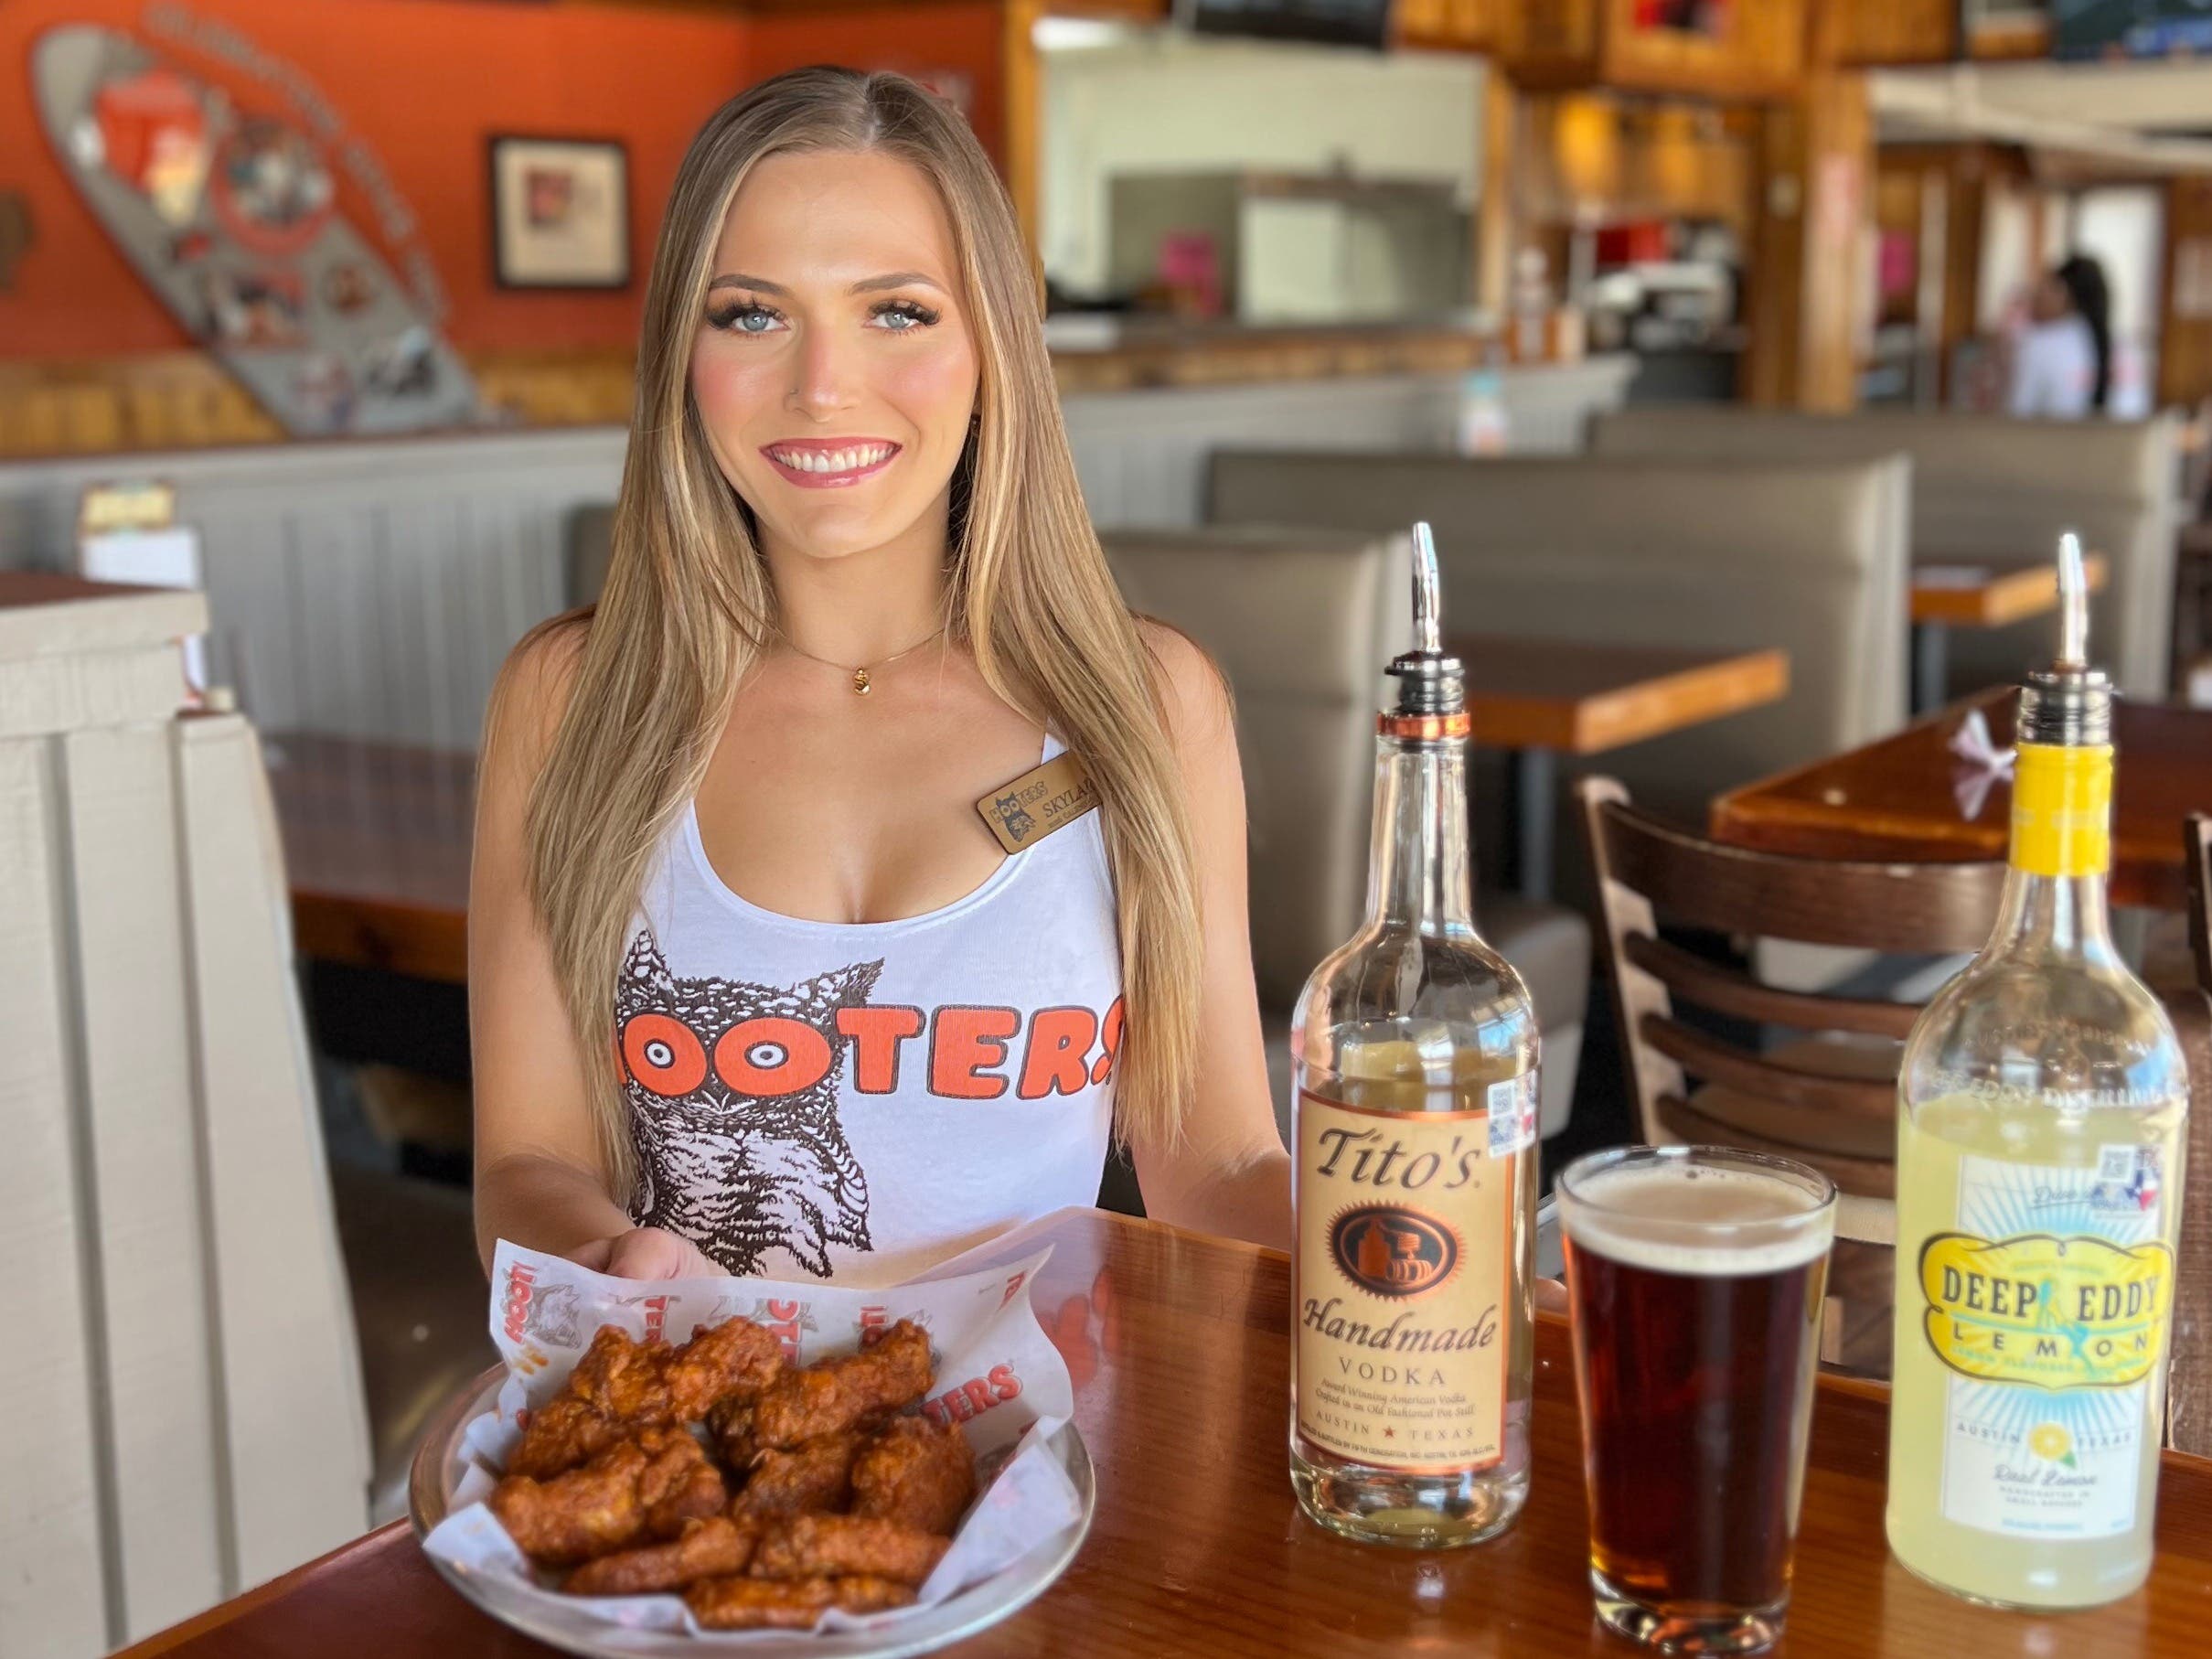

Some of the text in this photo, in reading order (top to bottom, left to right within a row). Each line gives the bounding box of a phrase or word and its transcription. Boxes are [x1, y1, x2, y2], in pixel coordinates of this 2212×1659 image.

[988, 780, 1048, 823] HOOTERS
[610, 994, 1125, 1099] OOTER
[1317, 1127, 1480, 1189] Tito's
[505, 1259, 540, 1345] HOOT
[1942, 1264, 2161, 1322] DEEP EDDY
[1303, 1297, 1498, 1354] Handmade
[1953, 1323, 2148, 1358] LEMON
[1339, 1355, 1446, 1385] VODKA
[1348, 1386, 1387, 1404] Winning
[1390, 1395, 1435, 1405] American
[1439, 1392, 1466, 1403] Vodka
[1317, 1410, 1369, 1434] AUSTIN
[1411, 1427, 1473, 1440] TEXAS
[1956, 1421, 2020, 1443] AUSTIN
